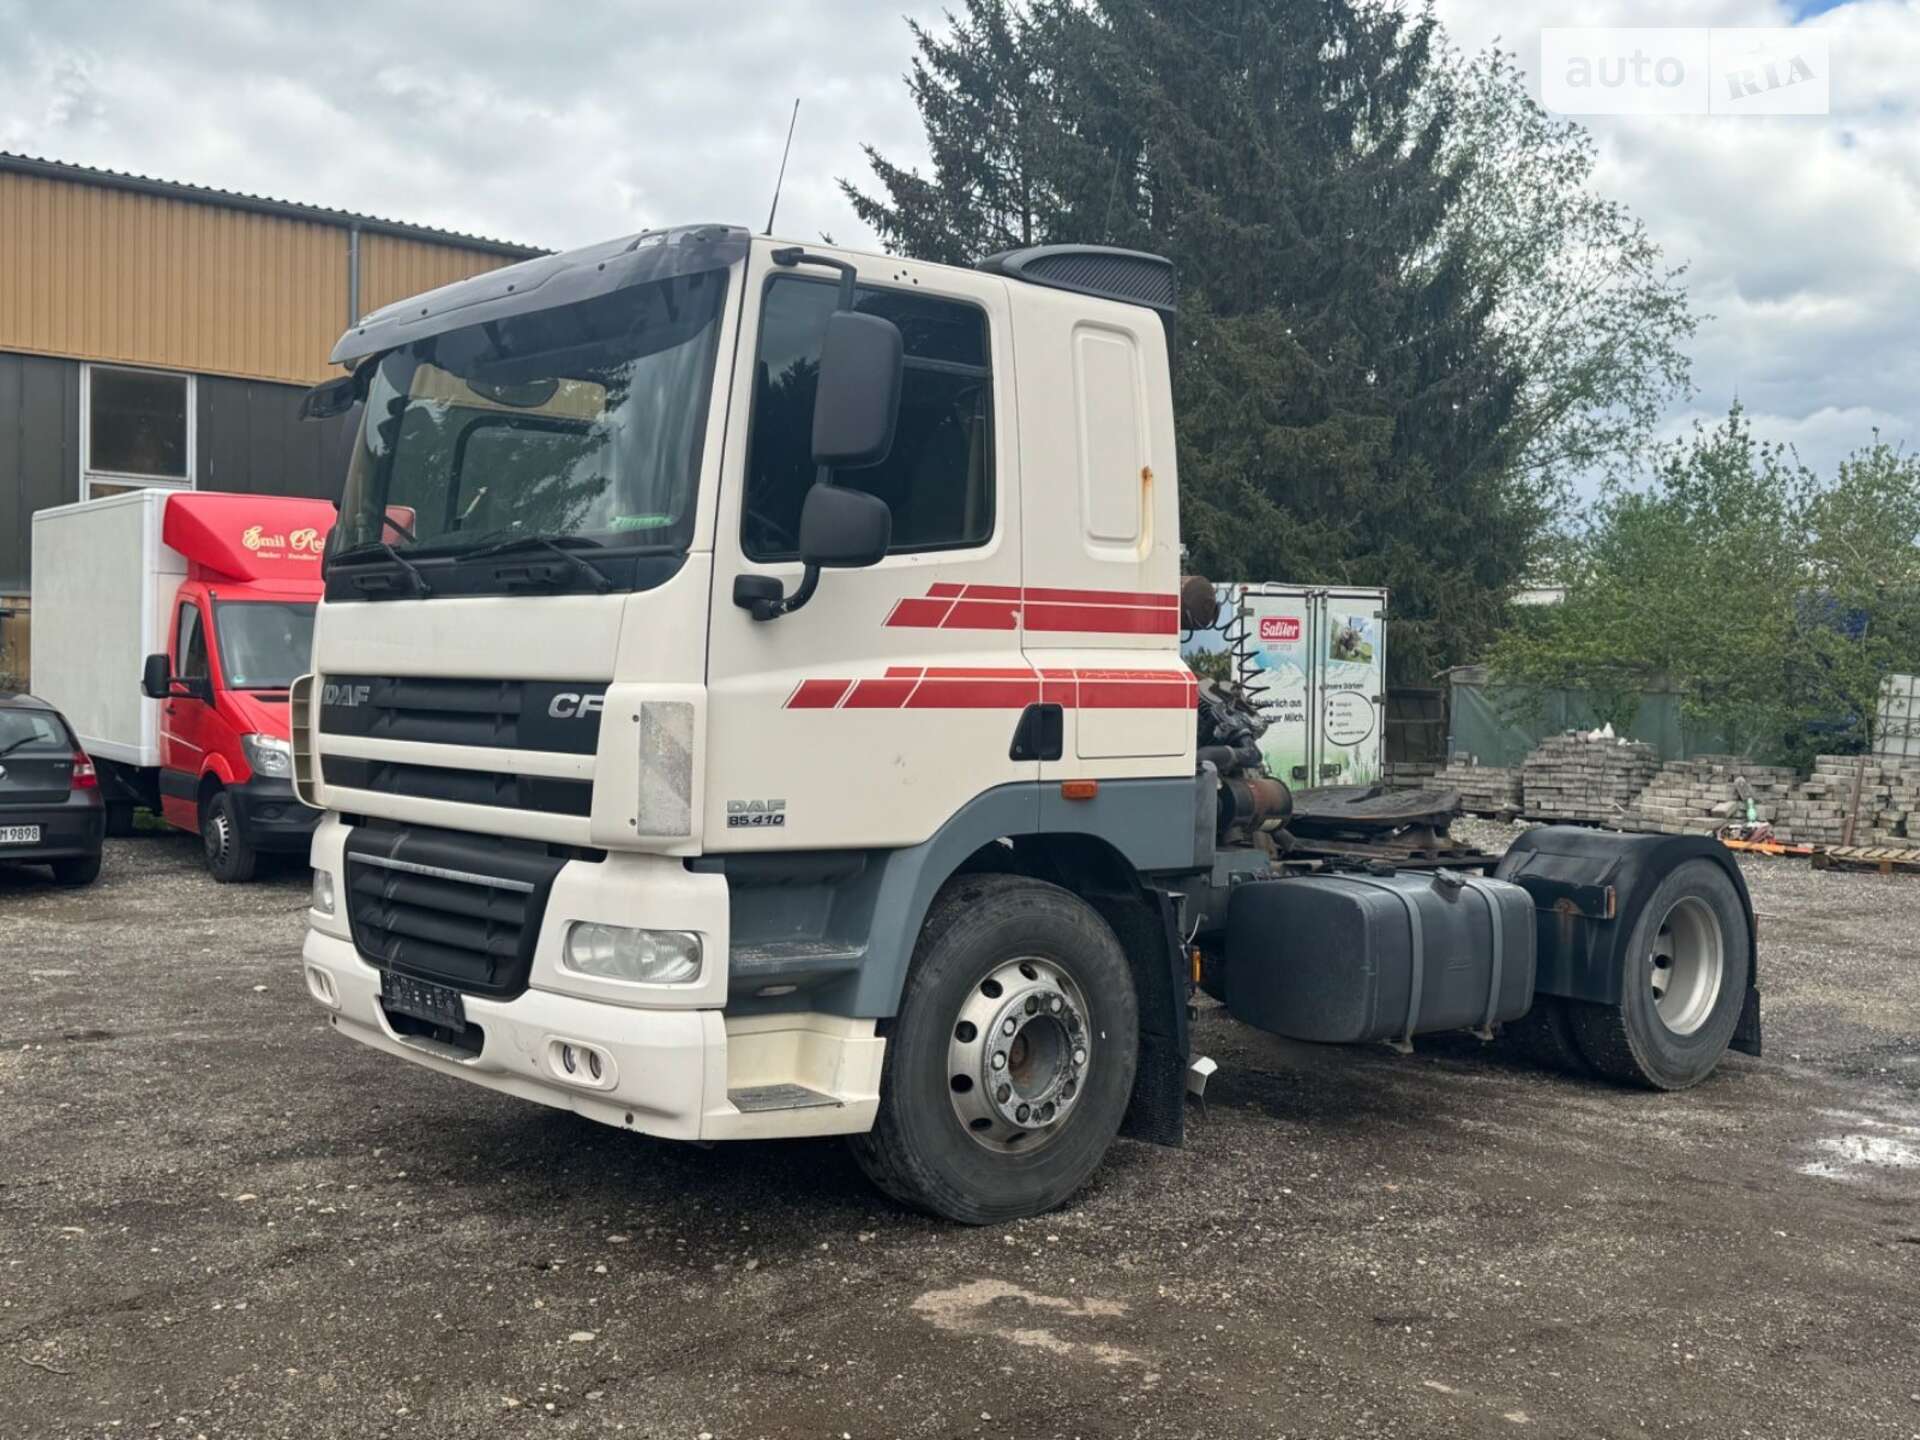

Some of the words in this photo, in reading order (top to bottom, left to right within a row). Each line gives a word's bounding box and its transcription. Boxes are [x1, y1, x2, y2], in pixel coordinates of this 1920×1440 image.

[242, 526, 285, 550] Emil
[323, 684, 371, 707] DAF
[548, 693, 604, 719] CF
[727, 800, 786, 813] DAF
[10, 827, 38, 841] 9898
